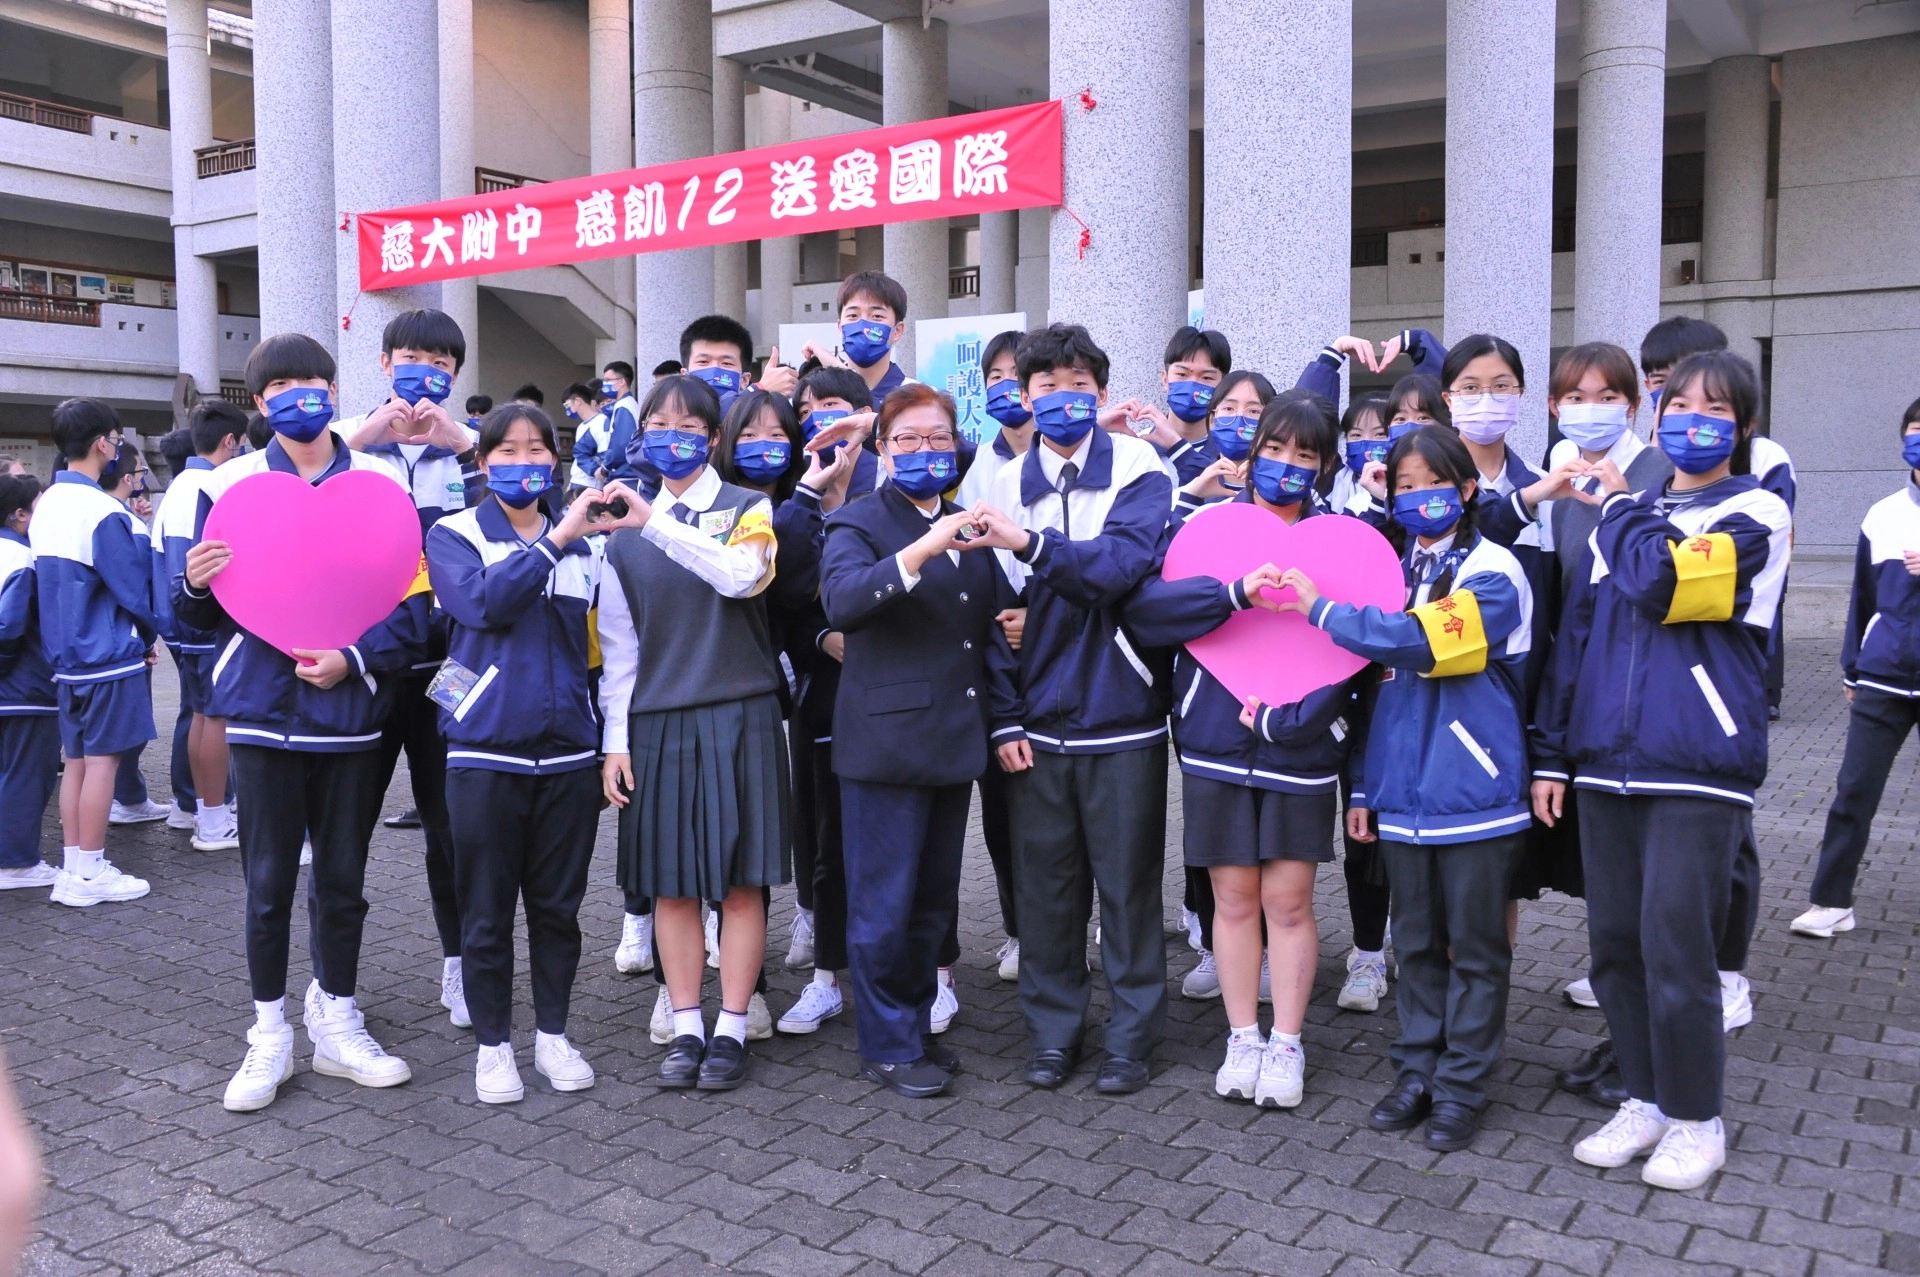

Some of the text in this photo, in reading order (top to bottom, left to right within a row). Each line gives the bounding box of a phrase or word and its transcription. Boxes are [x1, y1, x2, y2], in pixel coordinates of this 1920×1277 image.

[381, 130, 1009, 273] 慈大附中 感飢12 送愛國際
